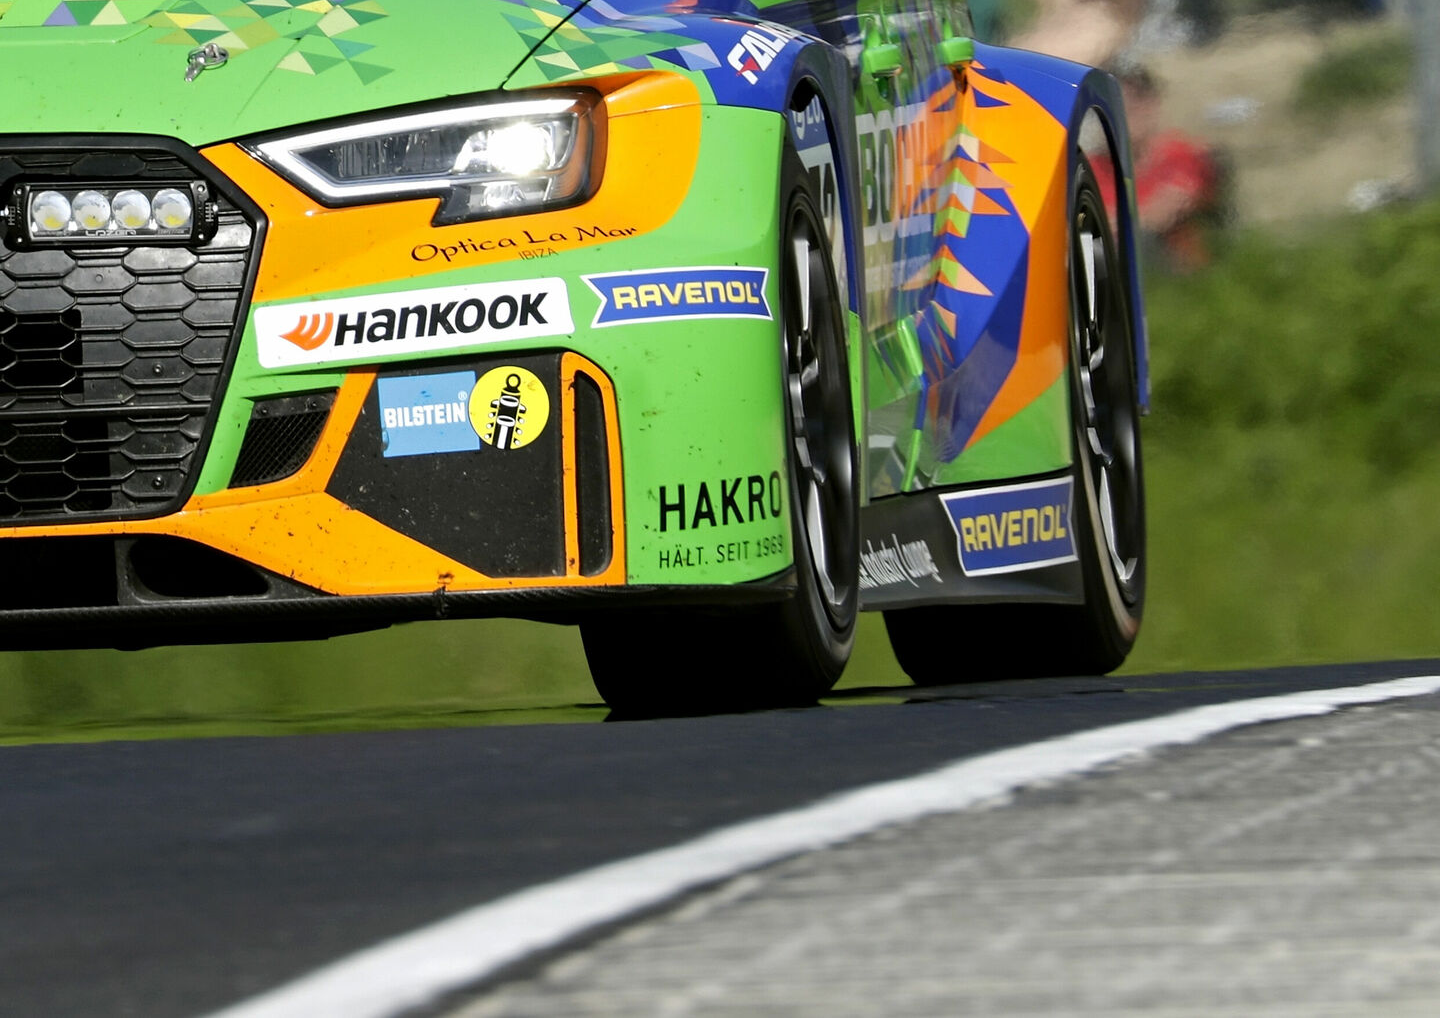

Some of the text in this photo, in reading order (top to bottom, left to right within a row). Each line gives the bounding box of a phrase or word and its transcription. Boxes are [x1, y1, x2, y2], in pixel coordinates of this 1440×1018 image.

[411, 226, 637, 262] Optica La Mar
[518, 247, 559, 261] IBIZA
[612, 281, 758, 310] RAVENOL
[383, 401, 466, 429] BILSTEIN
[659, 470, 781, 533] HAKRO
[960, 505, 1067, 553] RAVENOL
[659, 534, 783, 569] HÄLT. SEIT 1969
